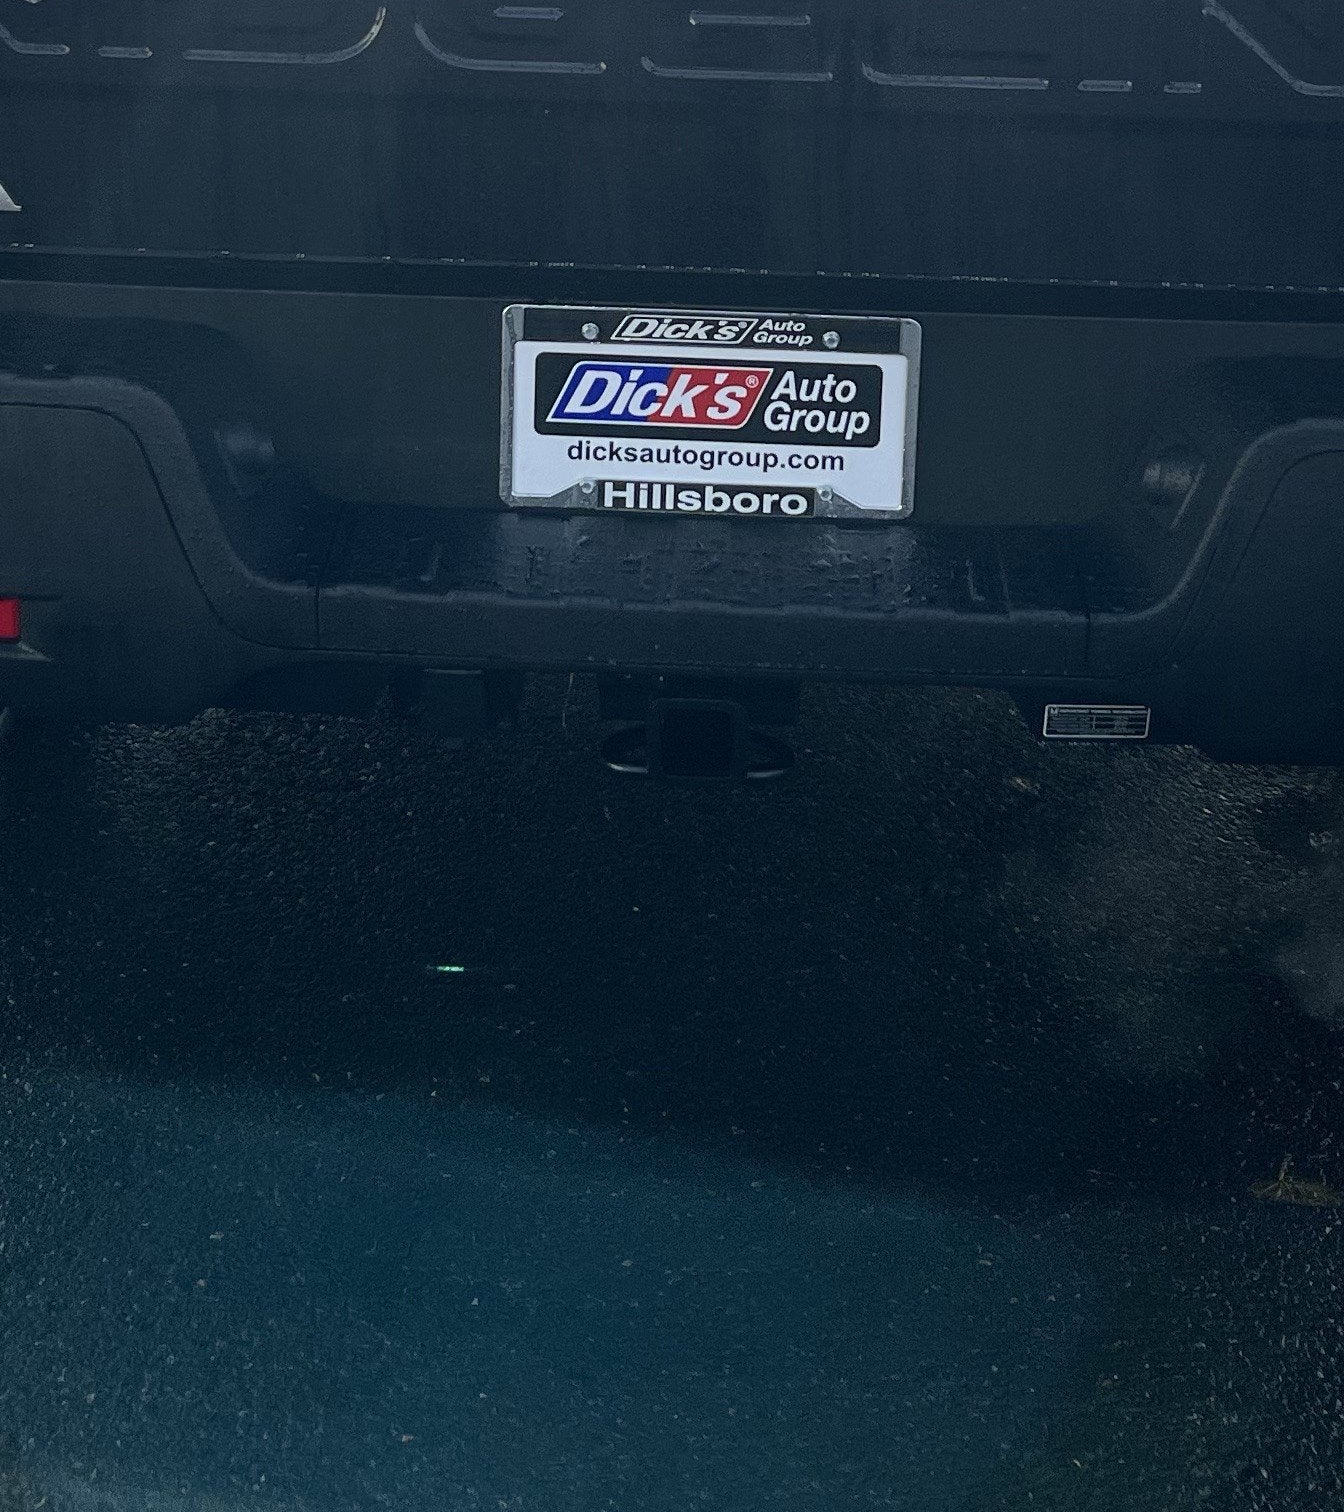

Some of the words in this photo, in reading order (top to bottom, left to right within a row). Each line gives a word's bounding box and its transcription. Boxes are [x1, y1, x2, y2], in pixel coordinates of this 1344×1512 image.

[621, 317, 740, 341] Dick's
[753, 331, 814, 346] Group
[758, 318, 806, 332] Auto
[563, 369, 748, 420] Dick's
[770, 370, 857, 404] Auto
[763, 400, 871, 440] Group
[567, 440, 845, 473] dicksautogroup.com
[603, 481, 809, 516] Hillsboro
